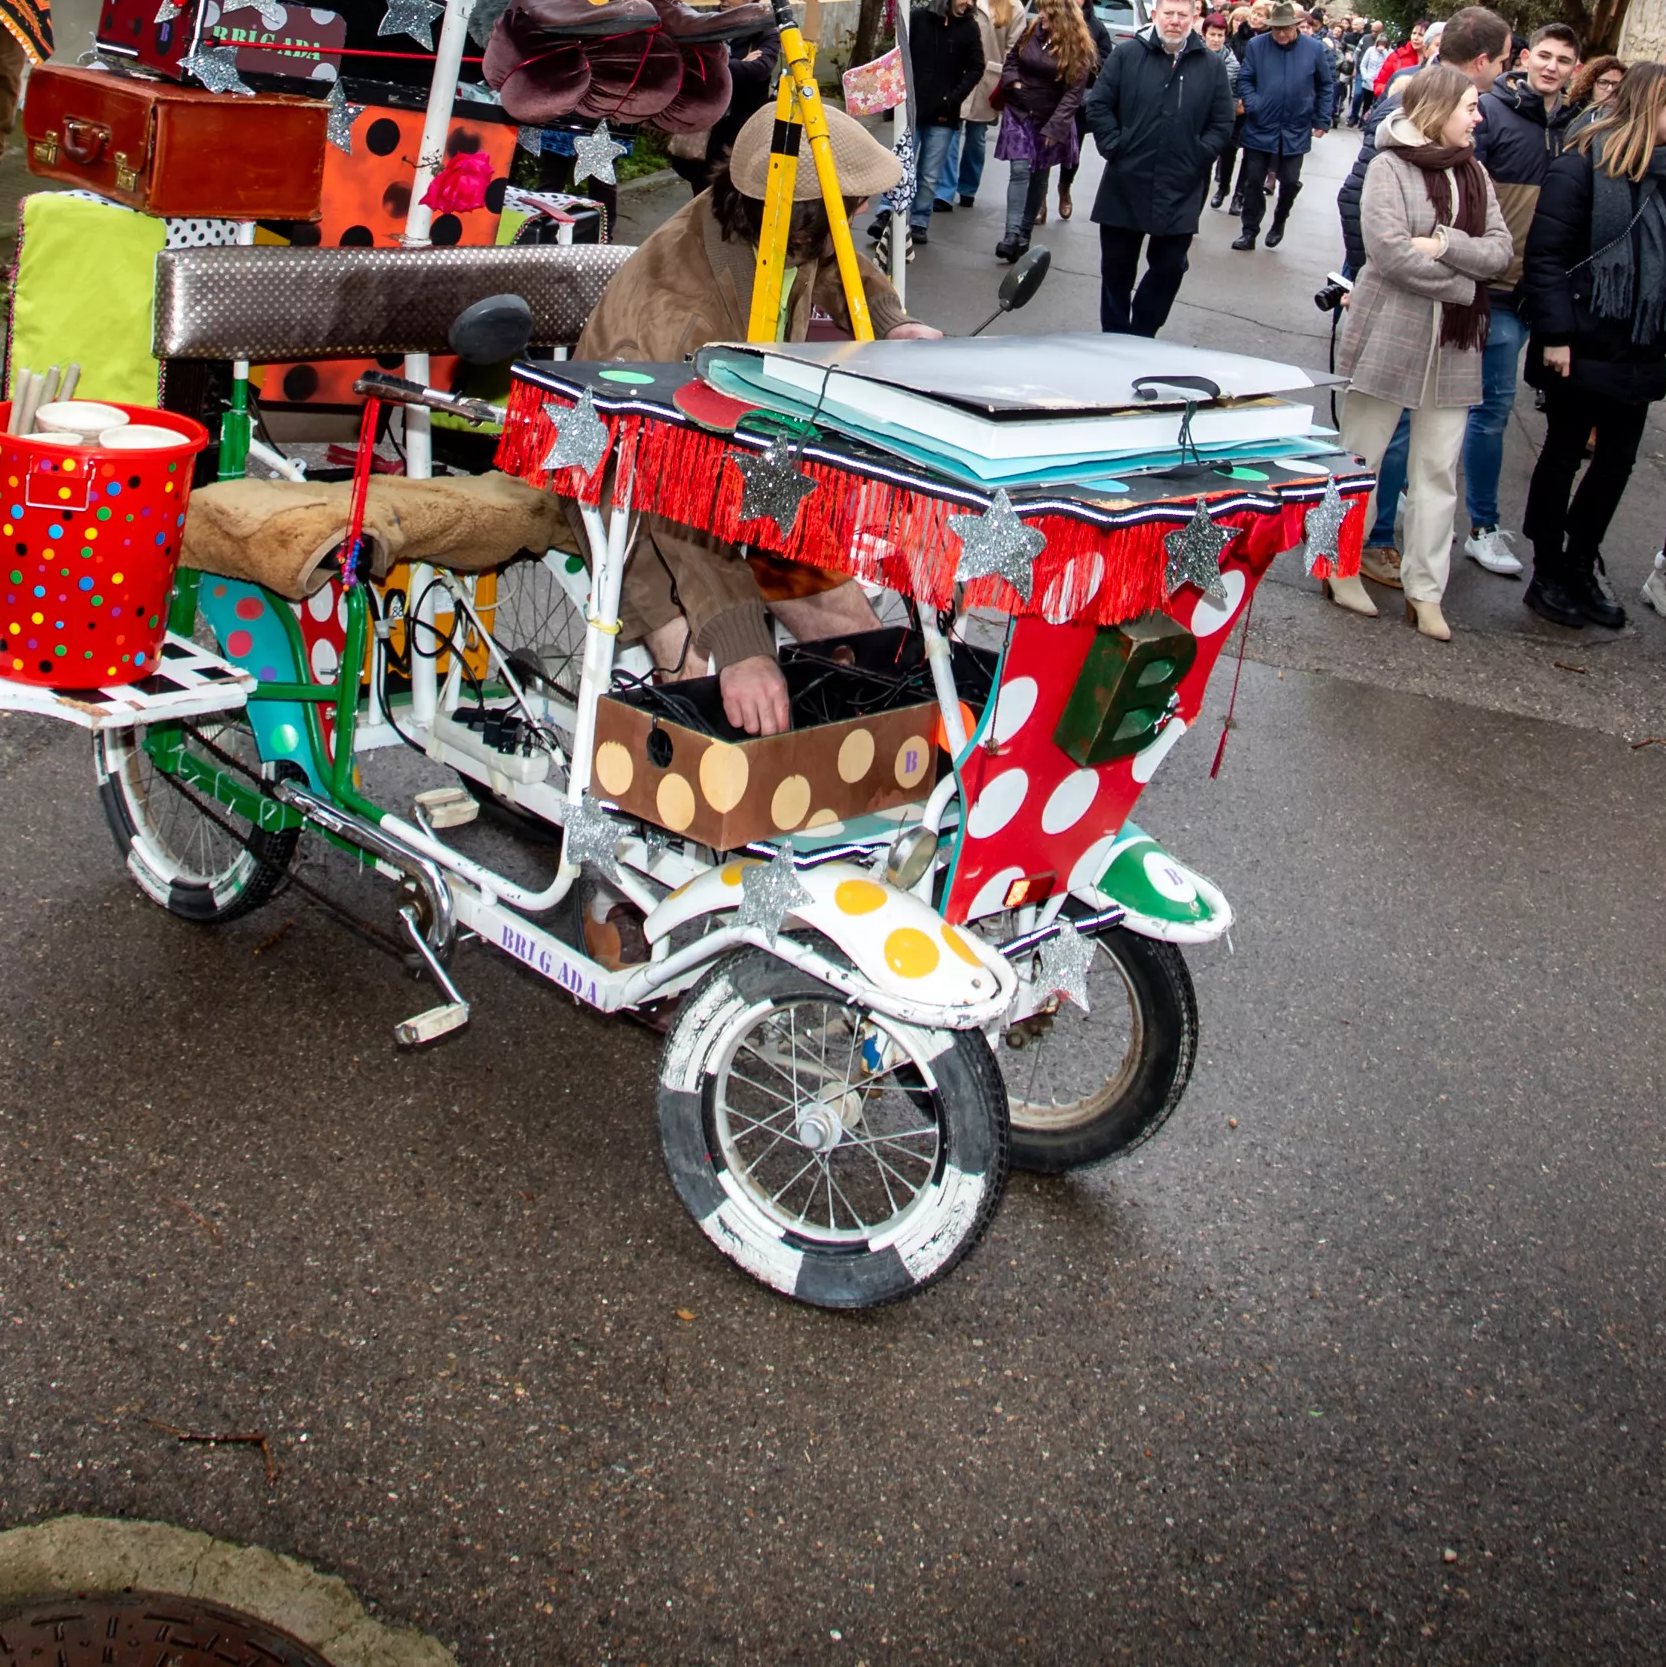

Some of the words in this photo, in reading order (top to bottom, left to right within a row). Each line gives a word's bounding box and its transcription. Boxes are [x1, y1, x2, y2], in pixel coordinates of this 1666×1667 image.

[1078, 626, 1198, 767] B
[905, 750, 919, 774] B
[1163, 867, 1184, 886] B
